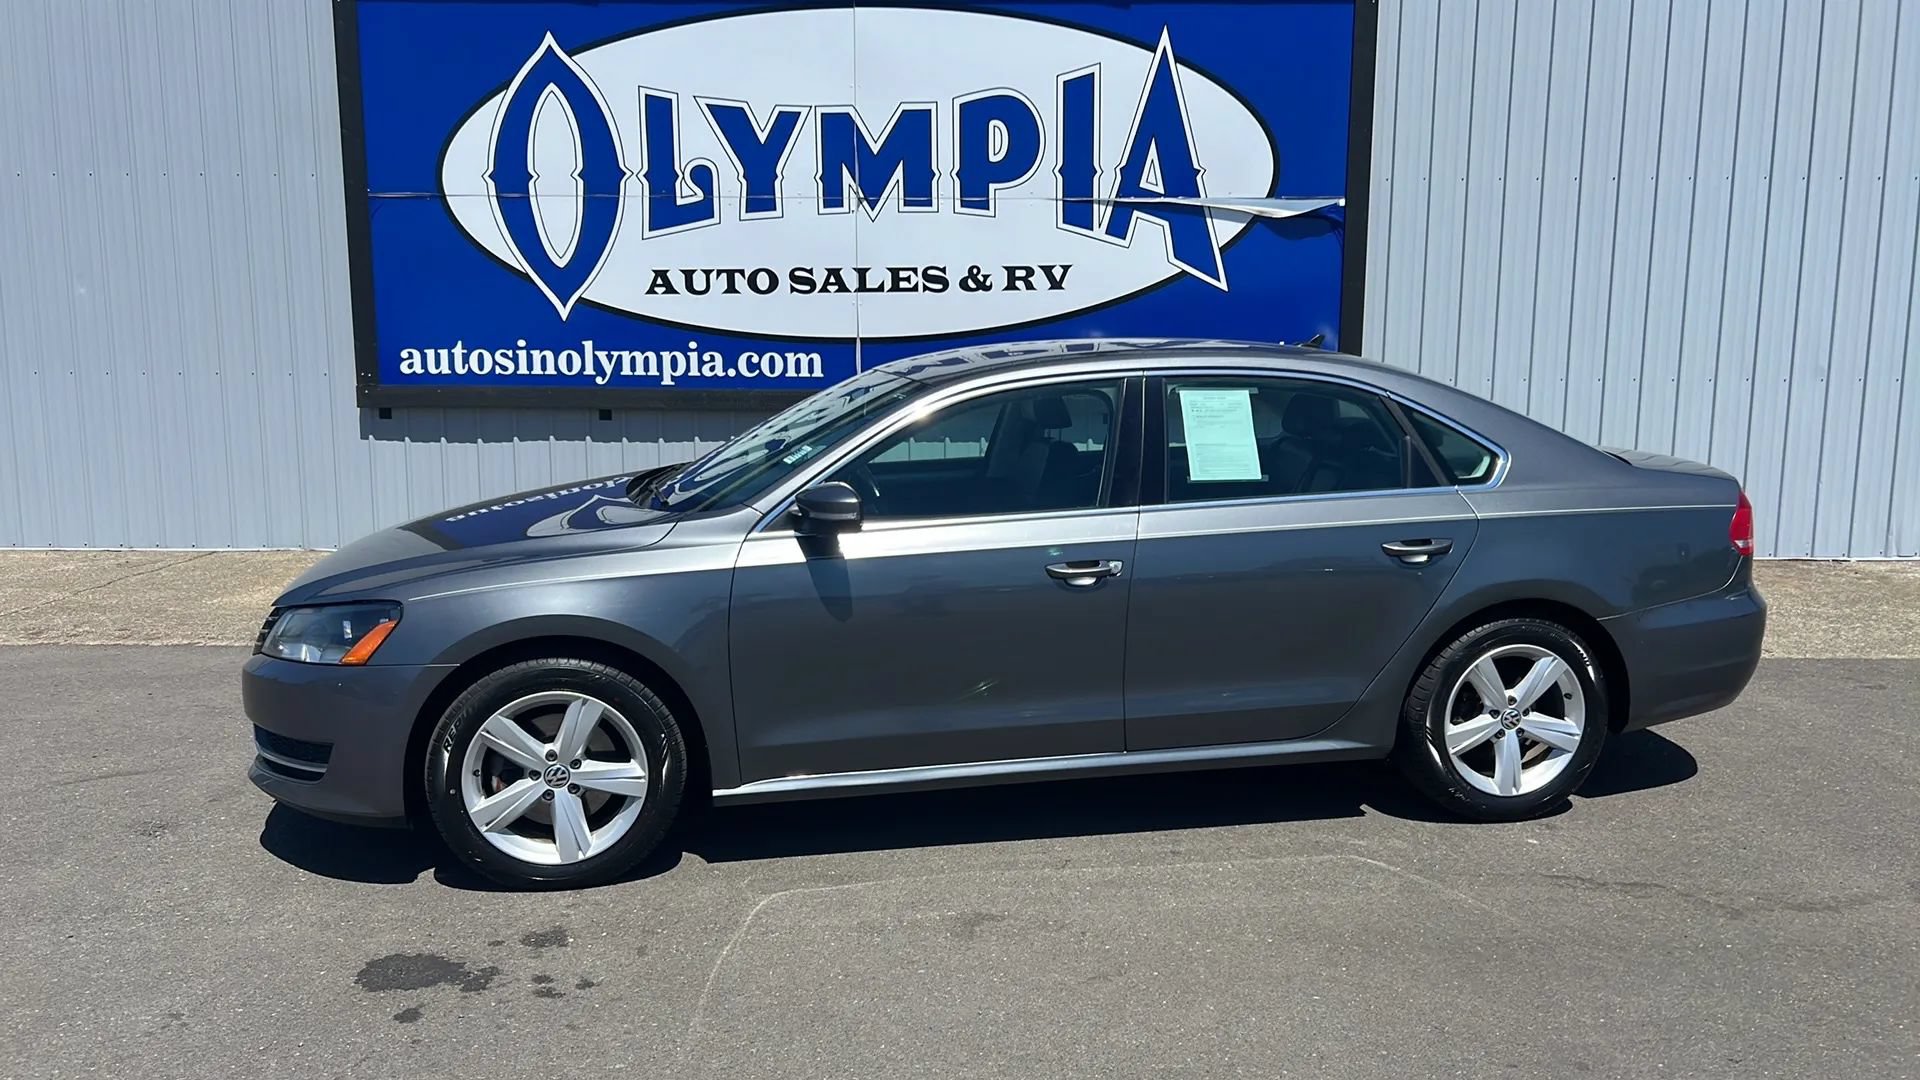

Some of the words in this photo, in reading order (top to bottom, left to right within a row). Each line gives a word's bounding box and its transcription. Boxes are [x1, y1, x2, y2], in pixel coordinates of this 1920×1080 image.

[483, 25, 1228, 322] OLYMPIA
[644, 267, 780, 296] AUTO
[788, 265, 950, 295] SALES
[958, 264, 993, 293] &
[1001, 264, 1074, 291] RV
[399, 339, 824, 386] autosinolympia.com
